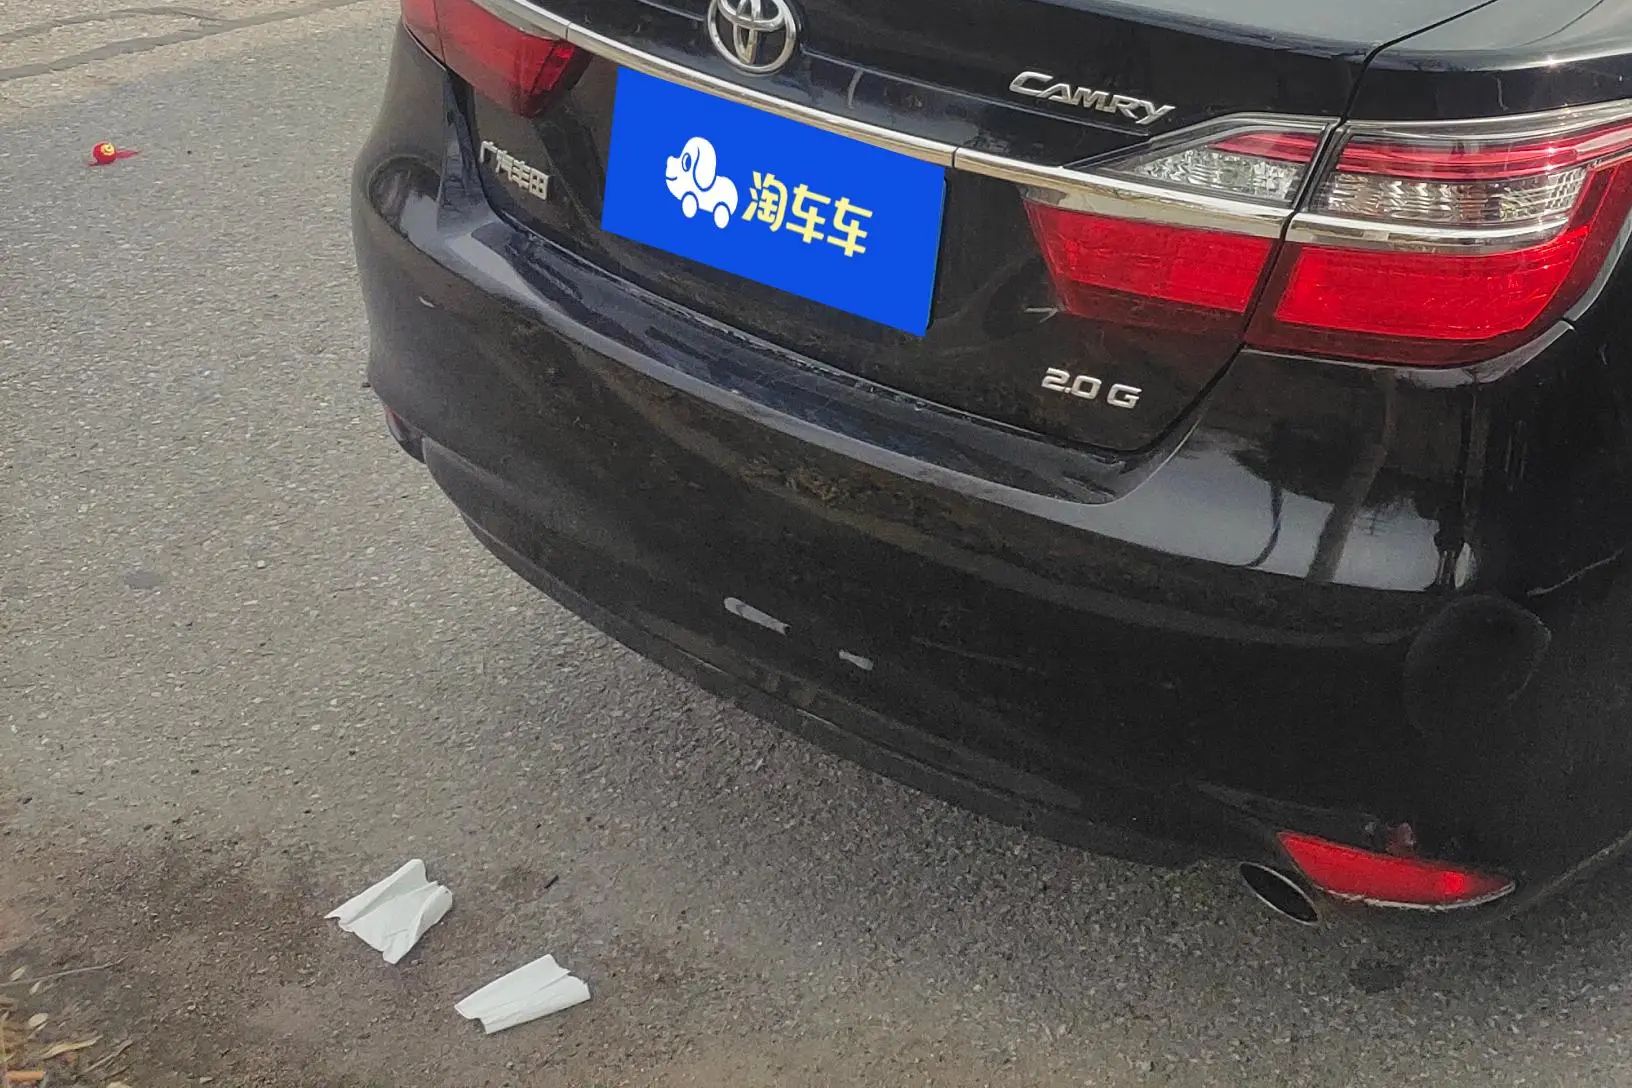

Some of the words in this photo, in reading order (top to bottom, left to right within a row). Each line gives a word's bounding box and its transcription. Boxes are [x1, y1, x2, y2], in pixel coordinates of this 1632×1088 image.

[1009, 71, 1176, 125] CAMRY
[480, 140, 549, 200] 广汽丰田
